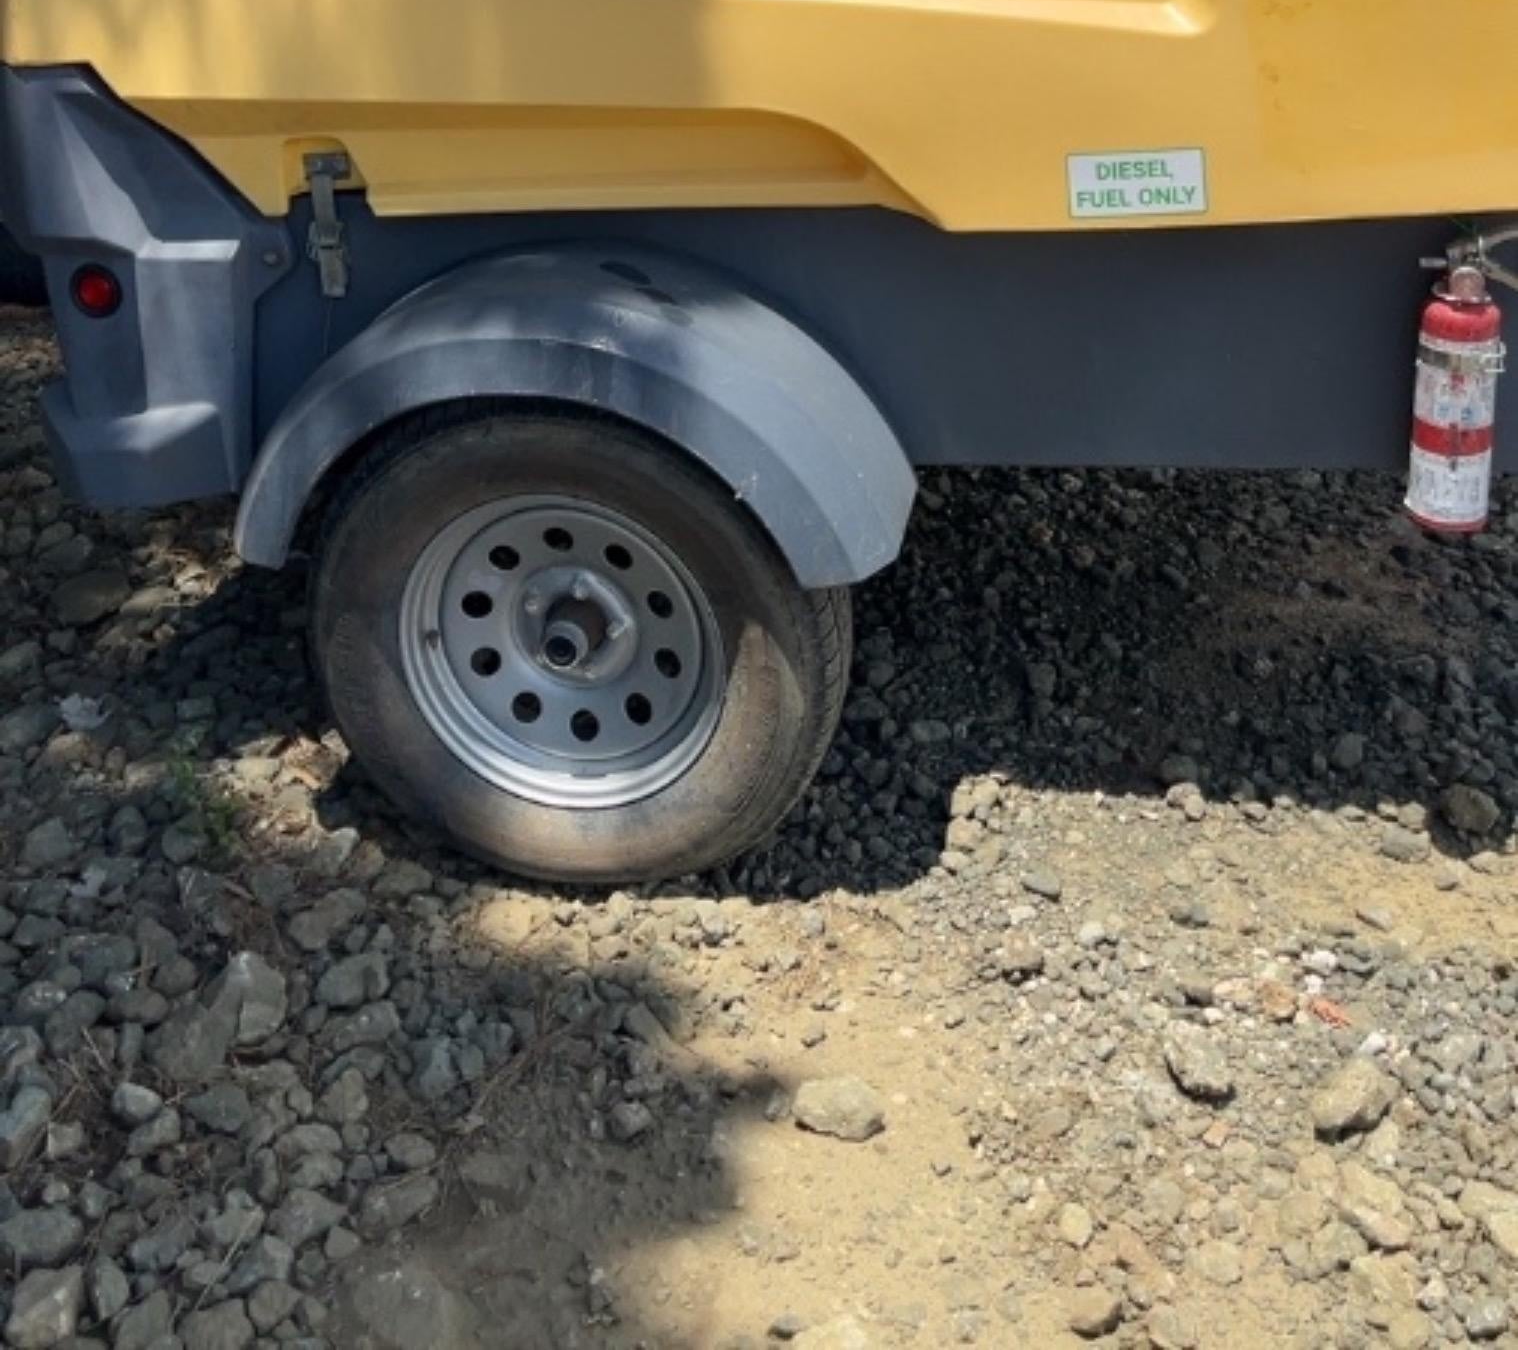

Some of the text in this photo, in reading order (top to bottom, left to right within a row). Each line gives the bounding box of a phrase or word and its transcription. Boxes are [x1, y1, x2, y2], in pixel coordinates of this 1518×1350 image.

[1095, 159, 1174, 181] DIESEL
[1076, 186, 1197, 208] FUEL ONLY
